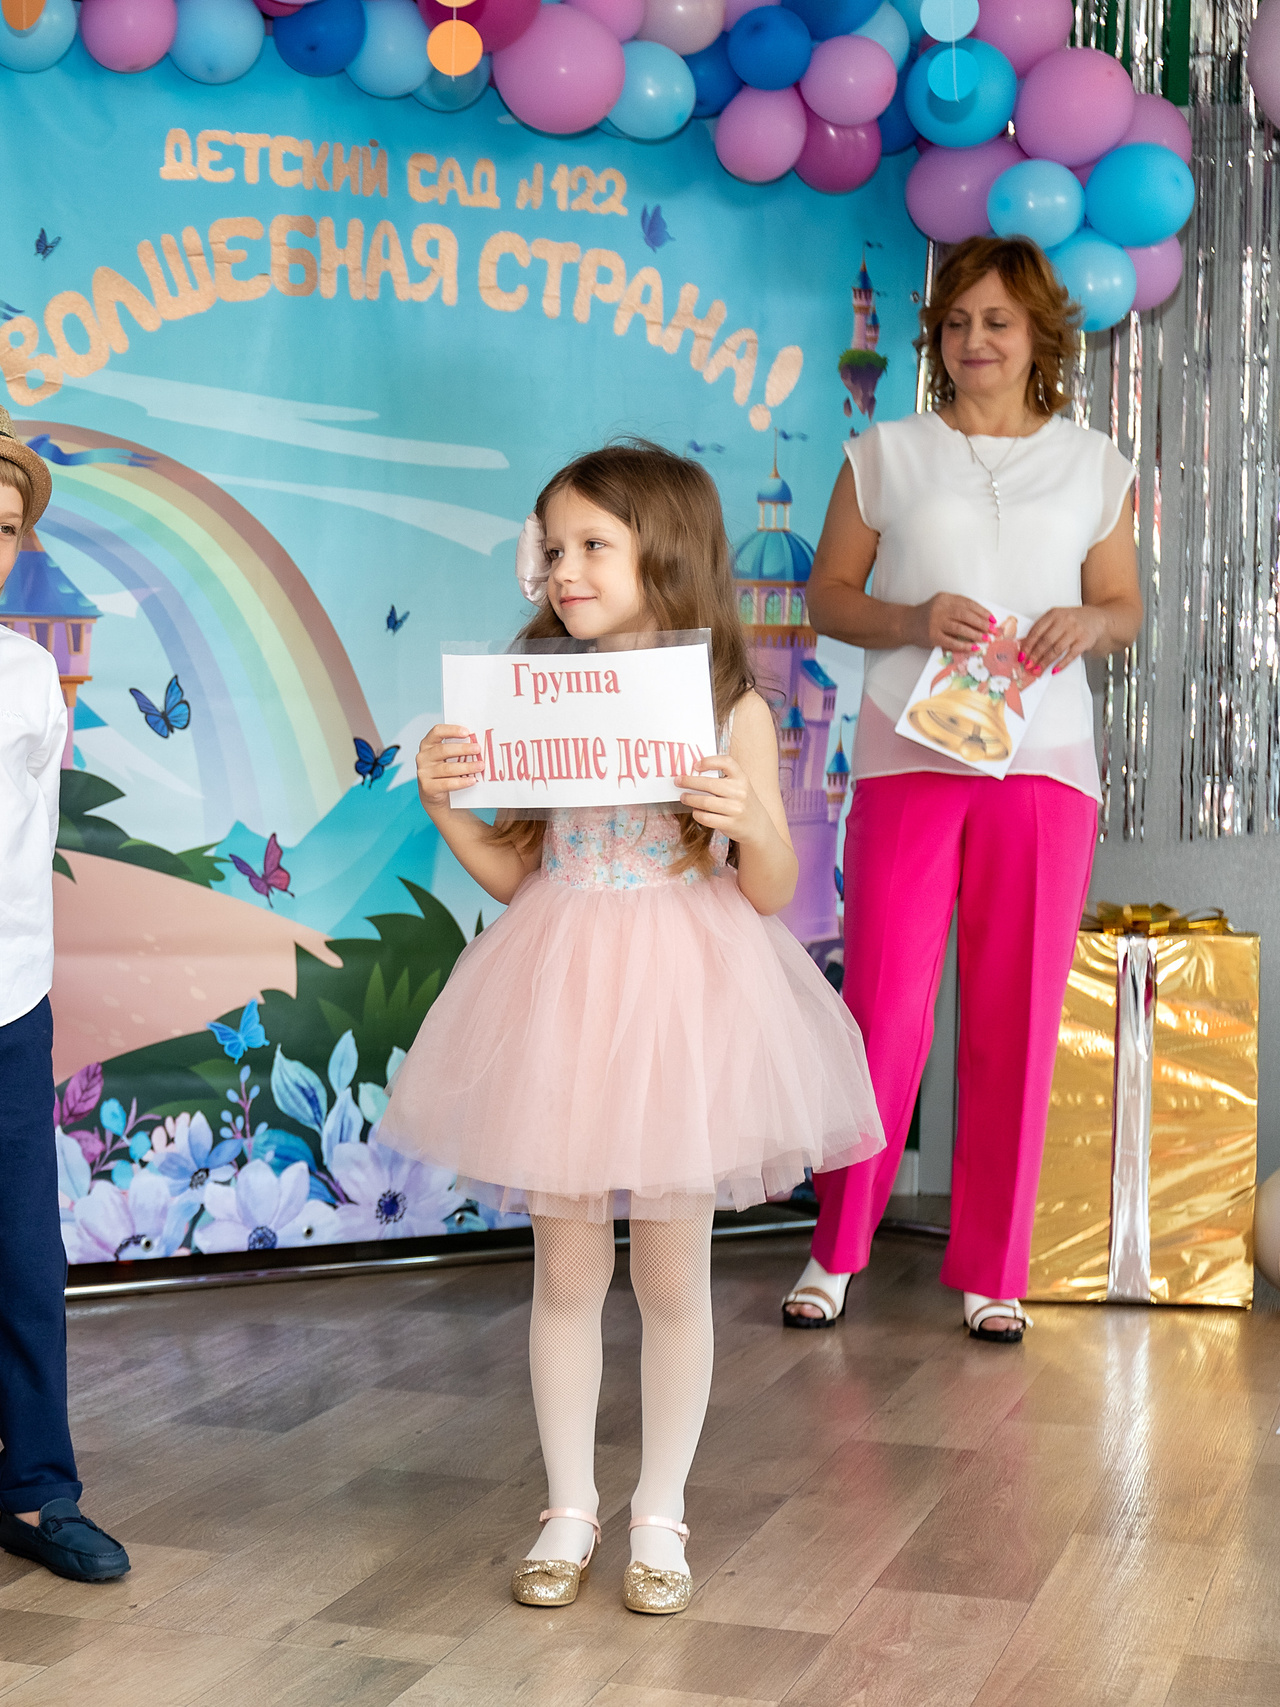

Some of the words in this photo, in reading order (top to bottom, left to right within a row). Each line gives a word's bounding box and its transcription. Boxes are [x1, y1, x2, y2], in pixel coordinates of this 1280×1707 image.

[159, 127, 389, 198] ДЕТСКИЙ
[407, 152, 501, 209] САД
[478, 230, 804, 432] СТРАНА!
[512, 664, 620, 704] Группа
[457, 728, 608, 790] Младшие
